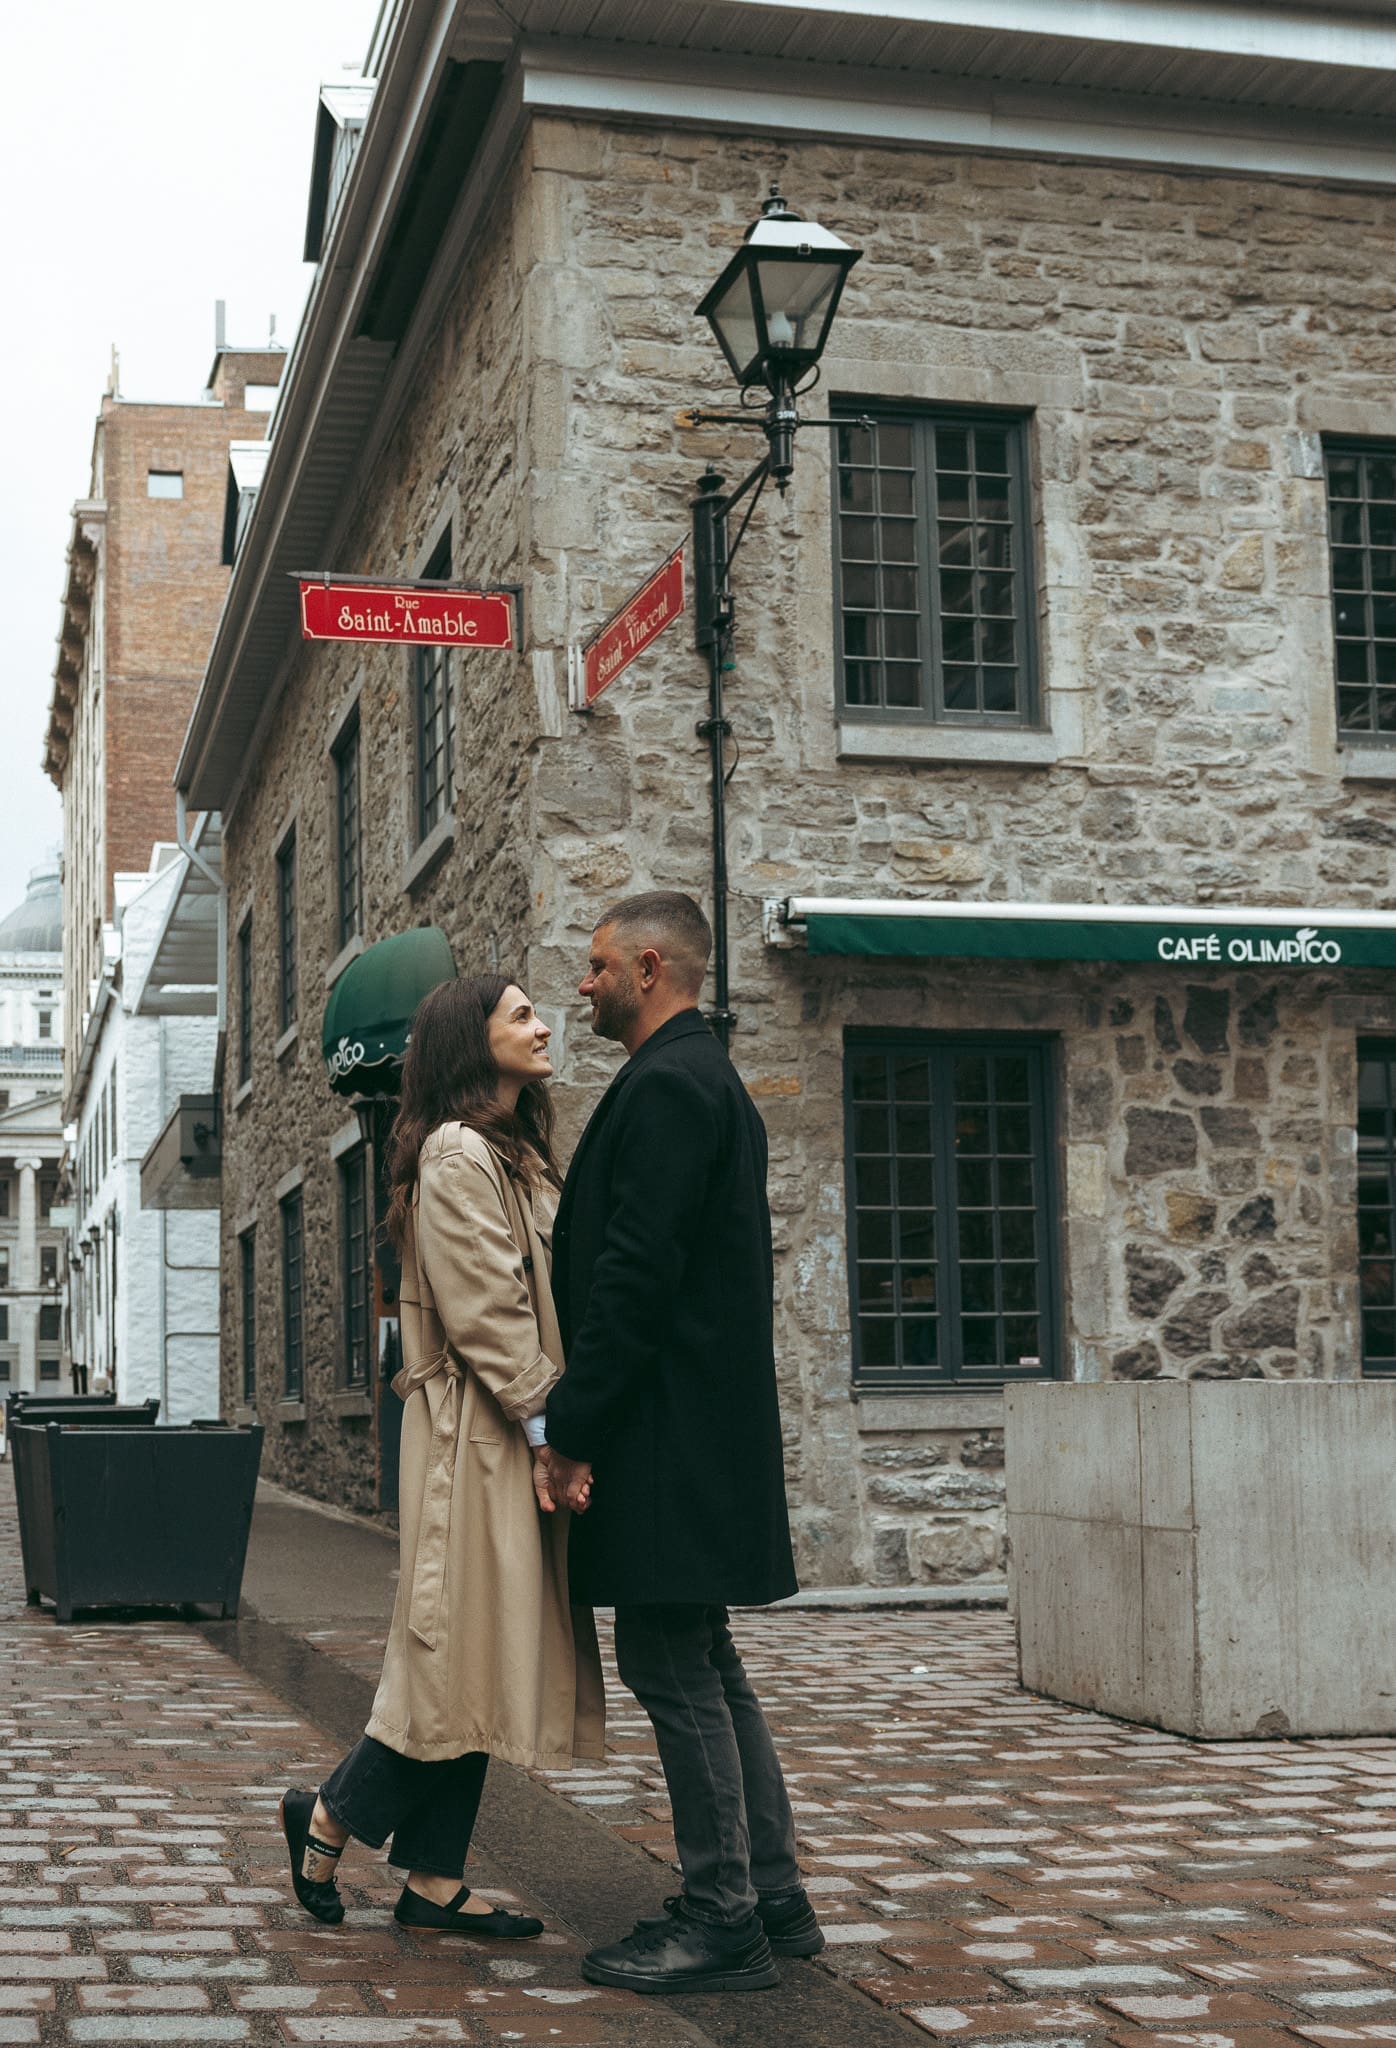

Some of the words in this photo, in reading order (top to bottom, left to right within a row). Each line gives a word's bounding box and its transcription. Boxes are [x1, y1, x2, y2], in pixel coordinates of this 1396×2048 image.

[394, 596, 420, 609] Rue
[337, 605, 478, 637] Saint-Amable
[597, 592, 668, 682] Saint-Vincent
[1157, 933, 1221, 961] CAFÉ
[1228, 927, 1341, 964] OLIMPICO
